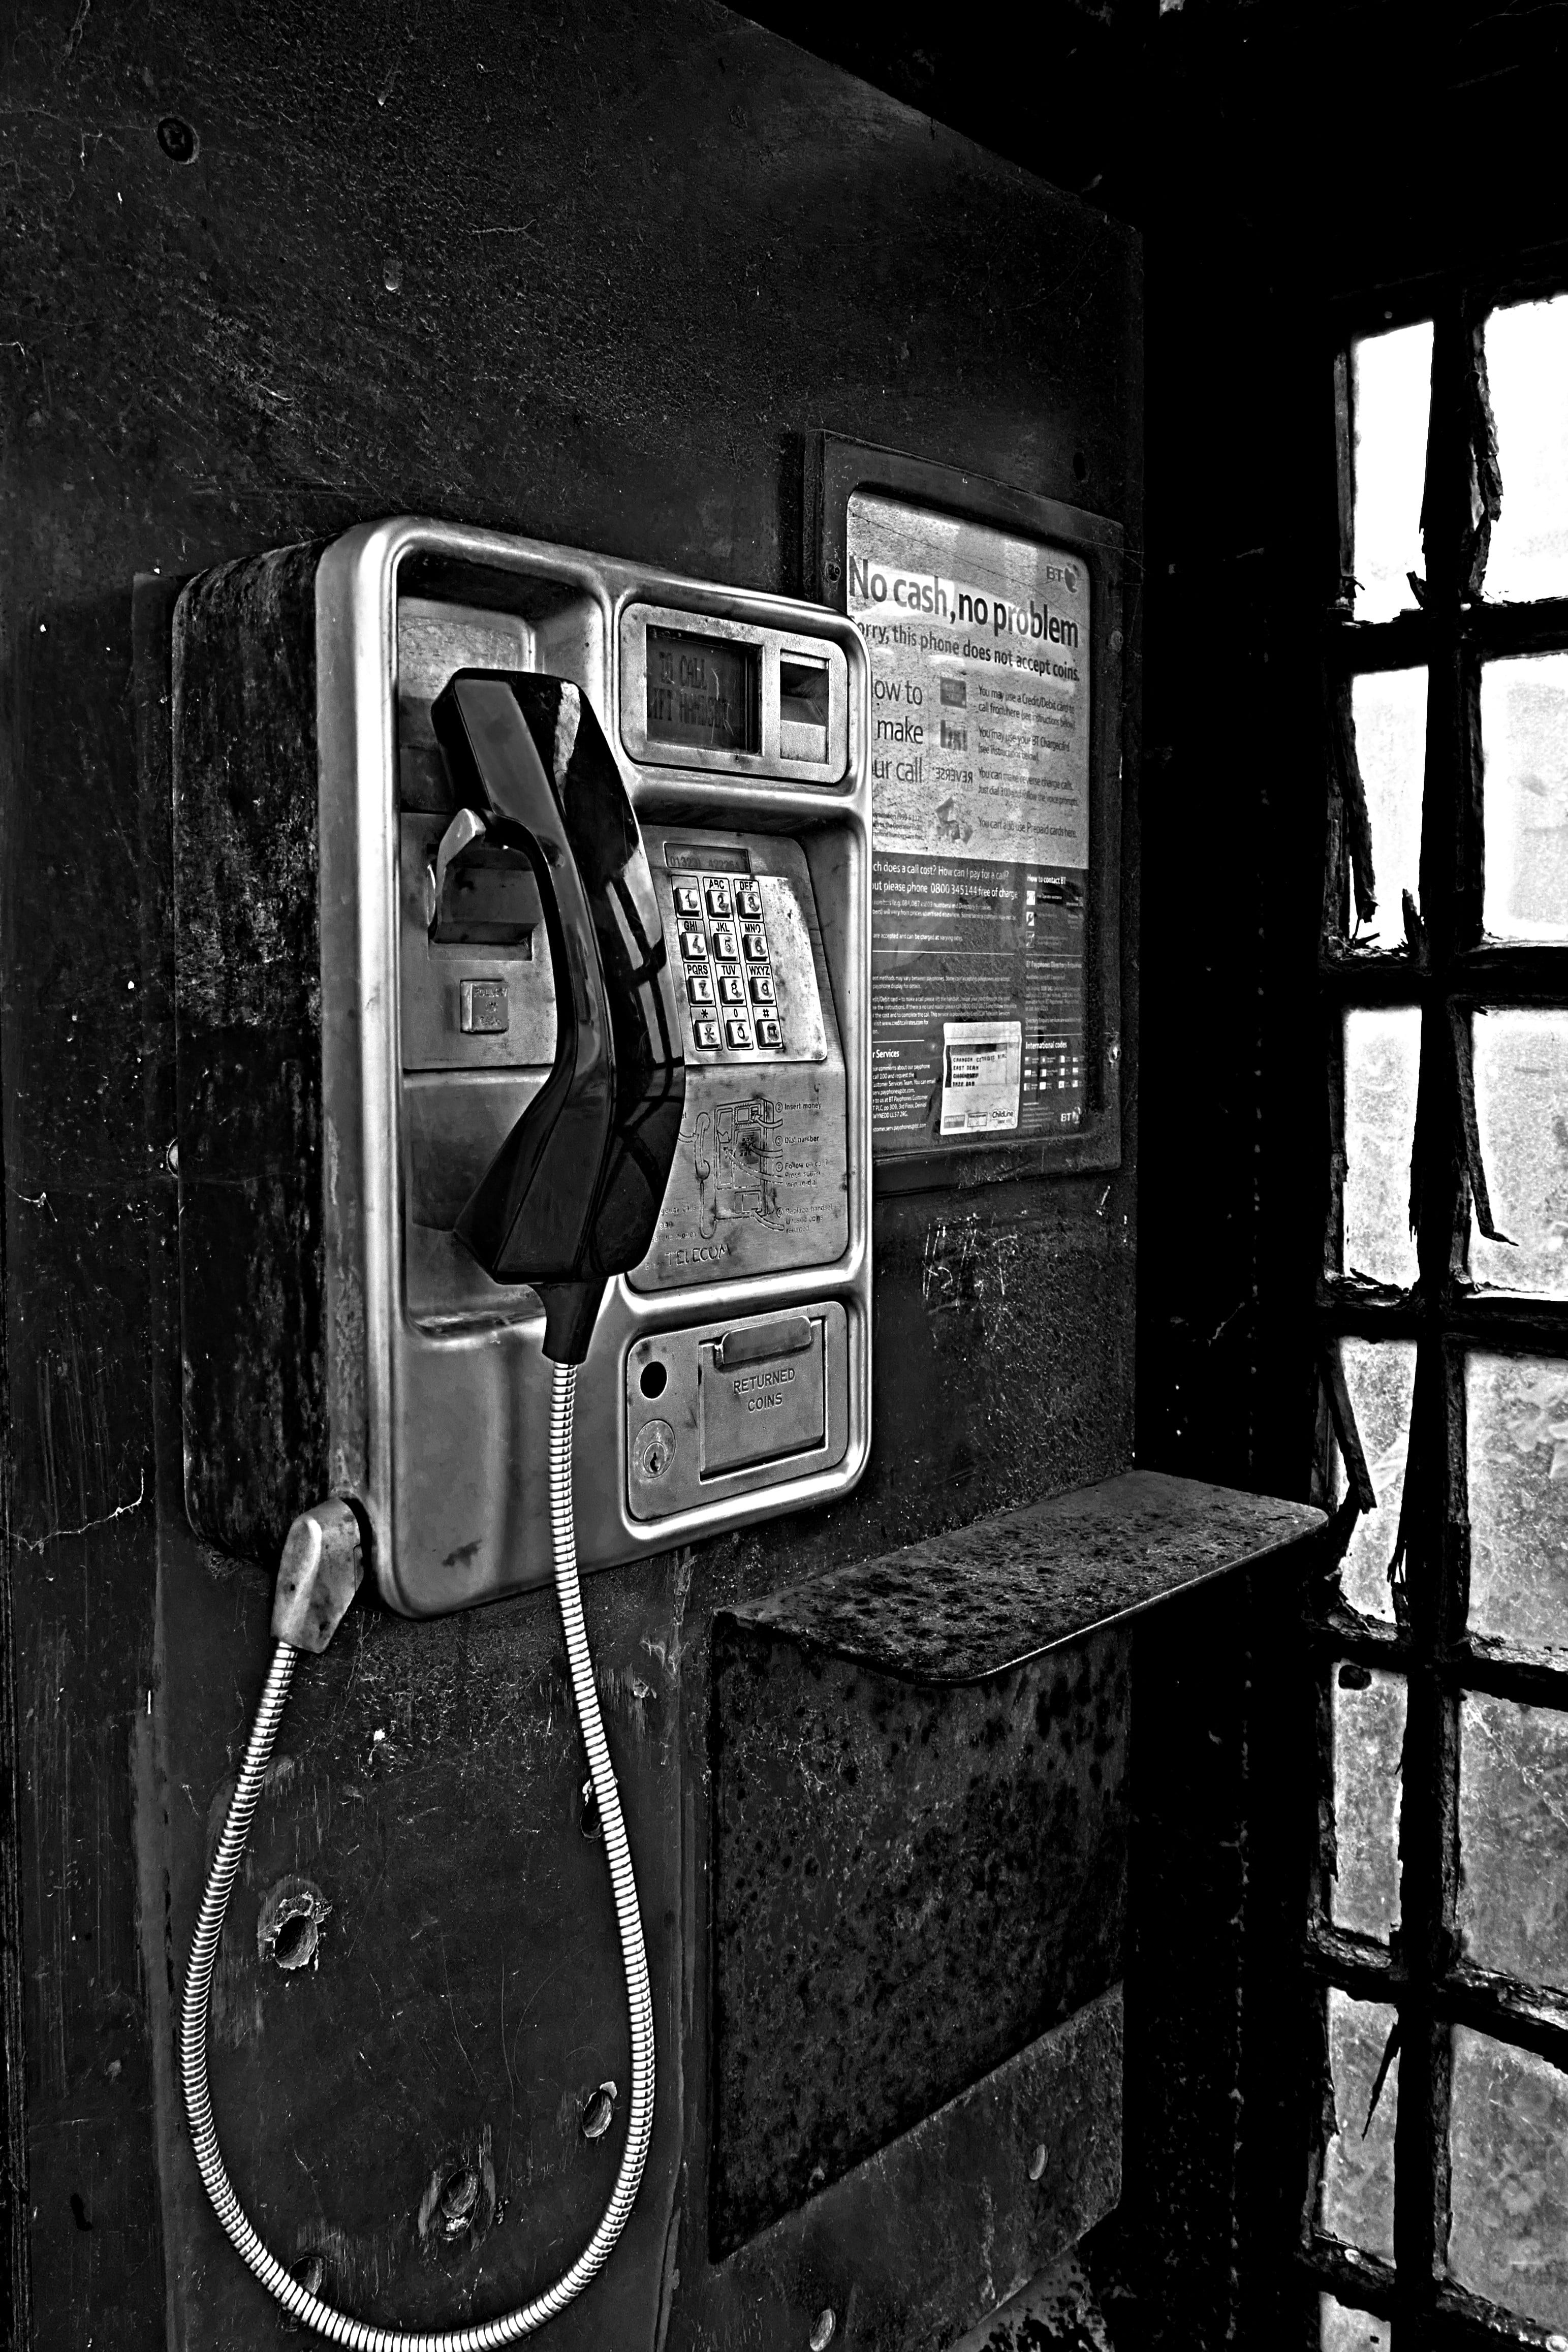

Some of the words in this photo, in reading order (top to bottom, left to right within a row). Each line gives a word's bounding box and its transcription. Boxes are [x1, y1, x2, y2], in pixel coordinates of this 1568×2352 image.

[1047, 566, 1063, 582] BT
[848, 555, 887, 602] No
[994, 601, 1078, 648] problem
[850, 614, 890, 644] orry,
[894, 625, 917, 647] this
[921, 634, 959, 655] phone
[963, 640, 991, 662] does
[994, 649, 1014, 667] not
[1016, 652, 1050, 676] accept
[1053, 658, 1080, 681] coins.
[872, 681, 901, 702] ow
[905, 680, 923, 705] to
[979, 684, 990, 697] You
[991, 690, 1004, 702] may
[979, 702, 989, 712] call
[990, 703, 1004, 715] from
[1005, 707, 1020, 718] here
[877, 716, 924, 744] make
[979, 726, 990, 738] You
[991, 730, 1004, 742] may
[1032, 735, 1039, 745] BT
[872, 760, 892, 779] ur
[896, 757, 922, 783] call
[979, 767, 989, 778] You
[991, 771, 1002, 779] can
[979, 784, 988, 794] Just
[989, 786, 999, 795] dial
[978, 817, 989, 828] You
[1027, 822, 1049, 835] Prepaid
[1050, 826, 1063, 836] cards
[884, 862, 900, 872] does
[907, 864, 919, 873] call
[920, 865, 936, 875] cost?
[938, 866, 952, 875] How
[969, 870, 980, 880] pay
[982, 869, 990, 879] for
[996, 870, 1009, 880] call?
[709, 879, 725, 889] ABC
[740, 881, 753, 891] DEF
[1060, 876, 1066, 885] BT
[872, 881, 882, 890] ut
[884, 881, 905, 892] please
[907, 882, 928, 894] phone
[931, 883, 950, 893] 0800
[952, 884, 977, 895] 345144
[979, 886, 990, 896] free
[992, 887, 998, 897] of
[999, 888, 1018, 900] charge
[684, 921, 698, 931] GHI
[716, 922, 730, 932] JKL
[744, 923, 761, 933] MNO
[687, 964, 708, 975] PQRS
[721, 965, 736, 975] TUV
[749, 966, 770, 976] WXYZ
[733, 1008, 738, 1017] 0
[1026, 1041, 1054, 1049] International
[876, 1049, 899, 1058] Services
[1061, 1113, 1072, 1122] BT
[665, 1244, 731, 1267] TELECOM
[734, 1368, 795, 1394] RETURNED
[748, 1393, 782, 1413] COINS
